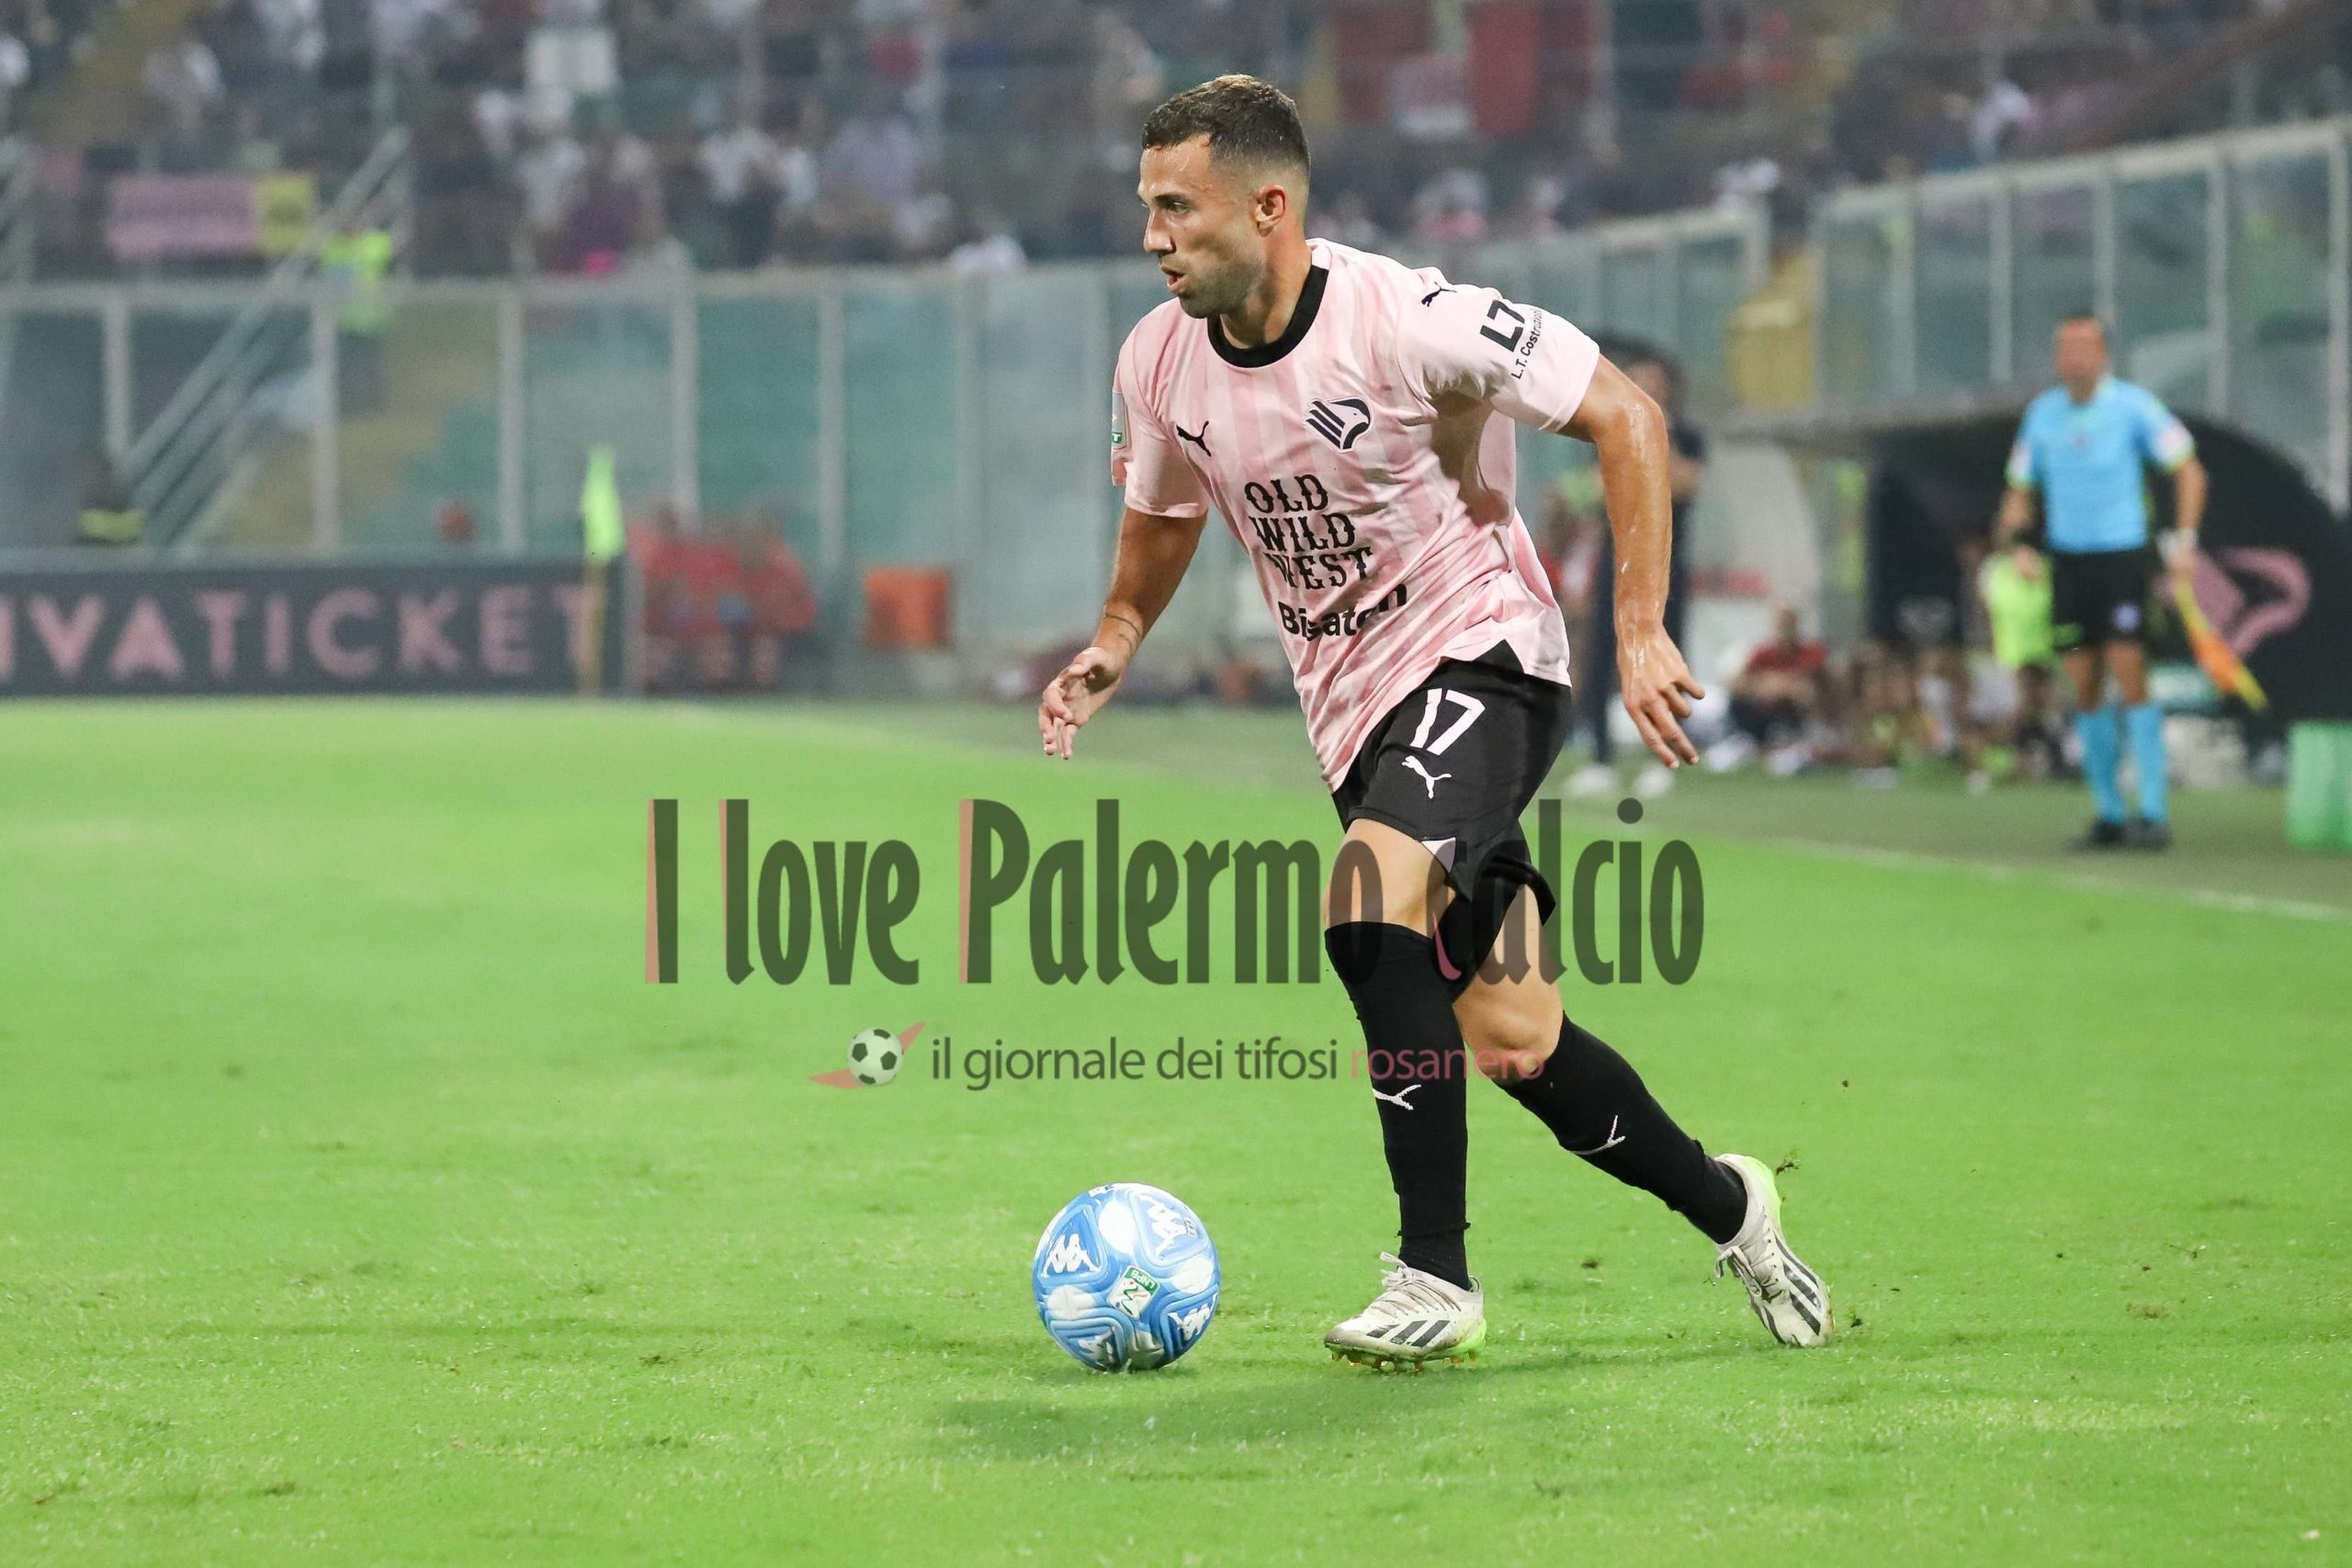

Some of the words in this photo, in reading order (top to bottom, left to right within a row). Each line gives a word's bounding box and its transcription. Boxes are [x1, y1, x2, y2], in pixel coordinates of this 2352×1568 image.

[1510, 358, 1528, 379] L.T.
[1244, 474, 1329, 513] OLD
[1249, 513, 1356, 553] WILD
[1263, 547, 1373, 590] WEST
[1409, 688, 1486, 756] 17
